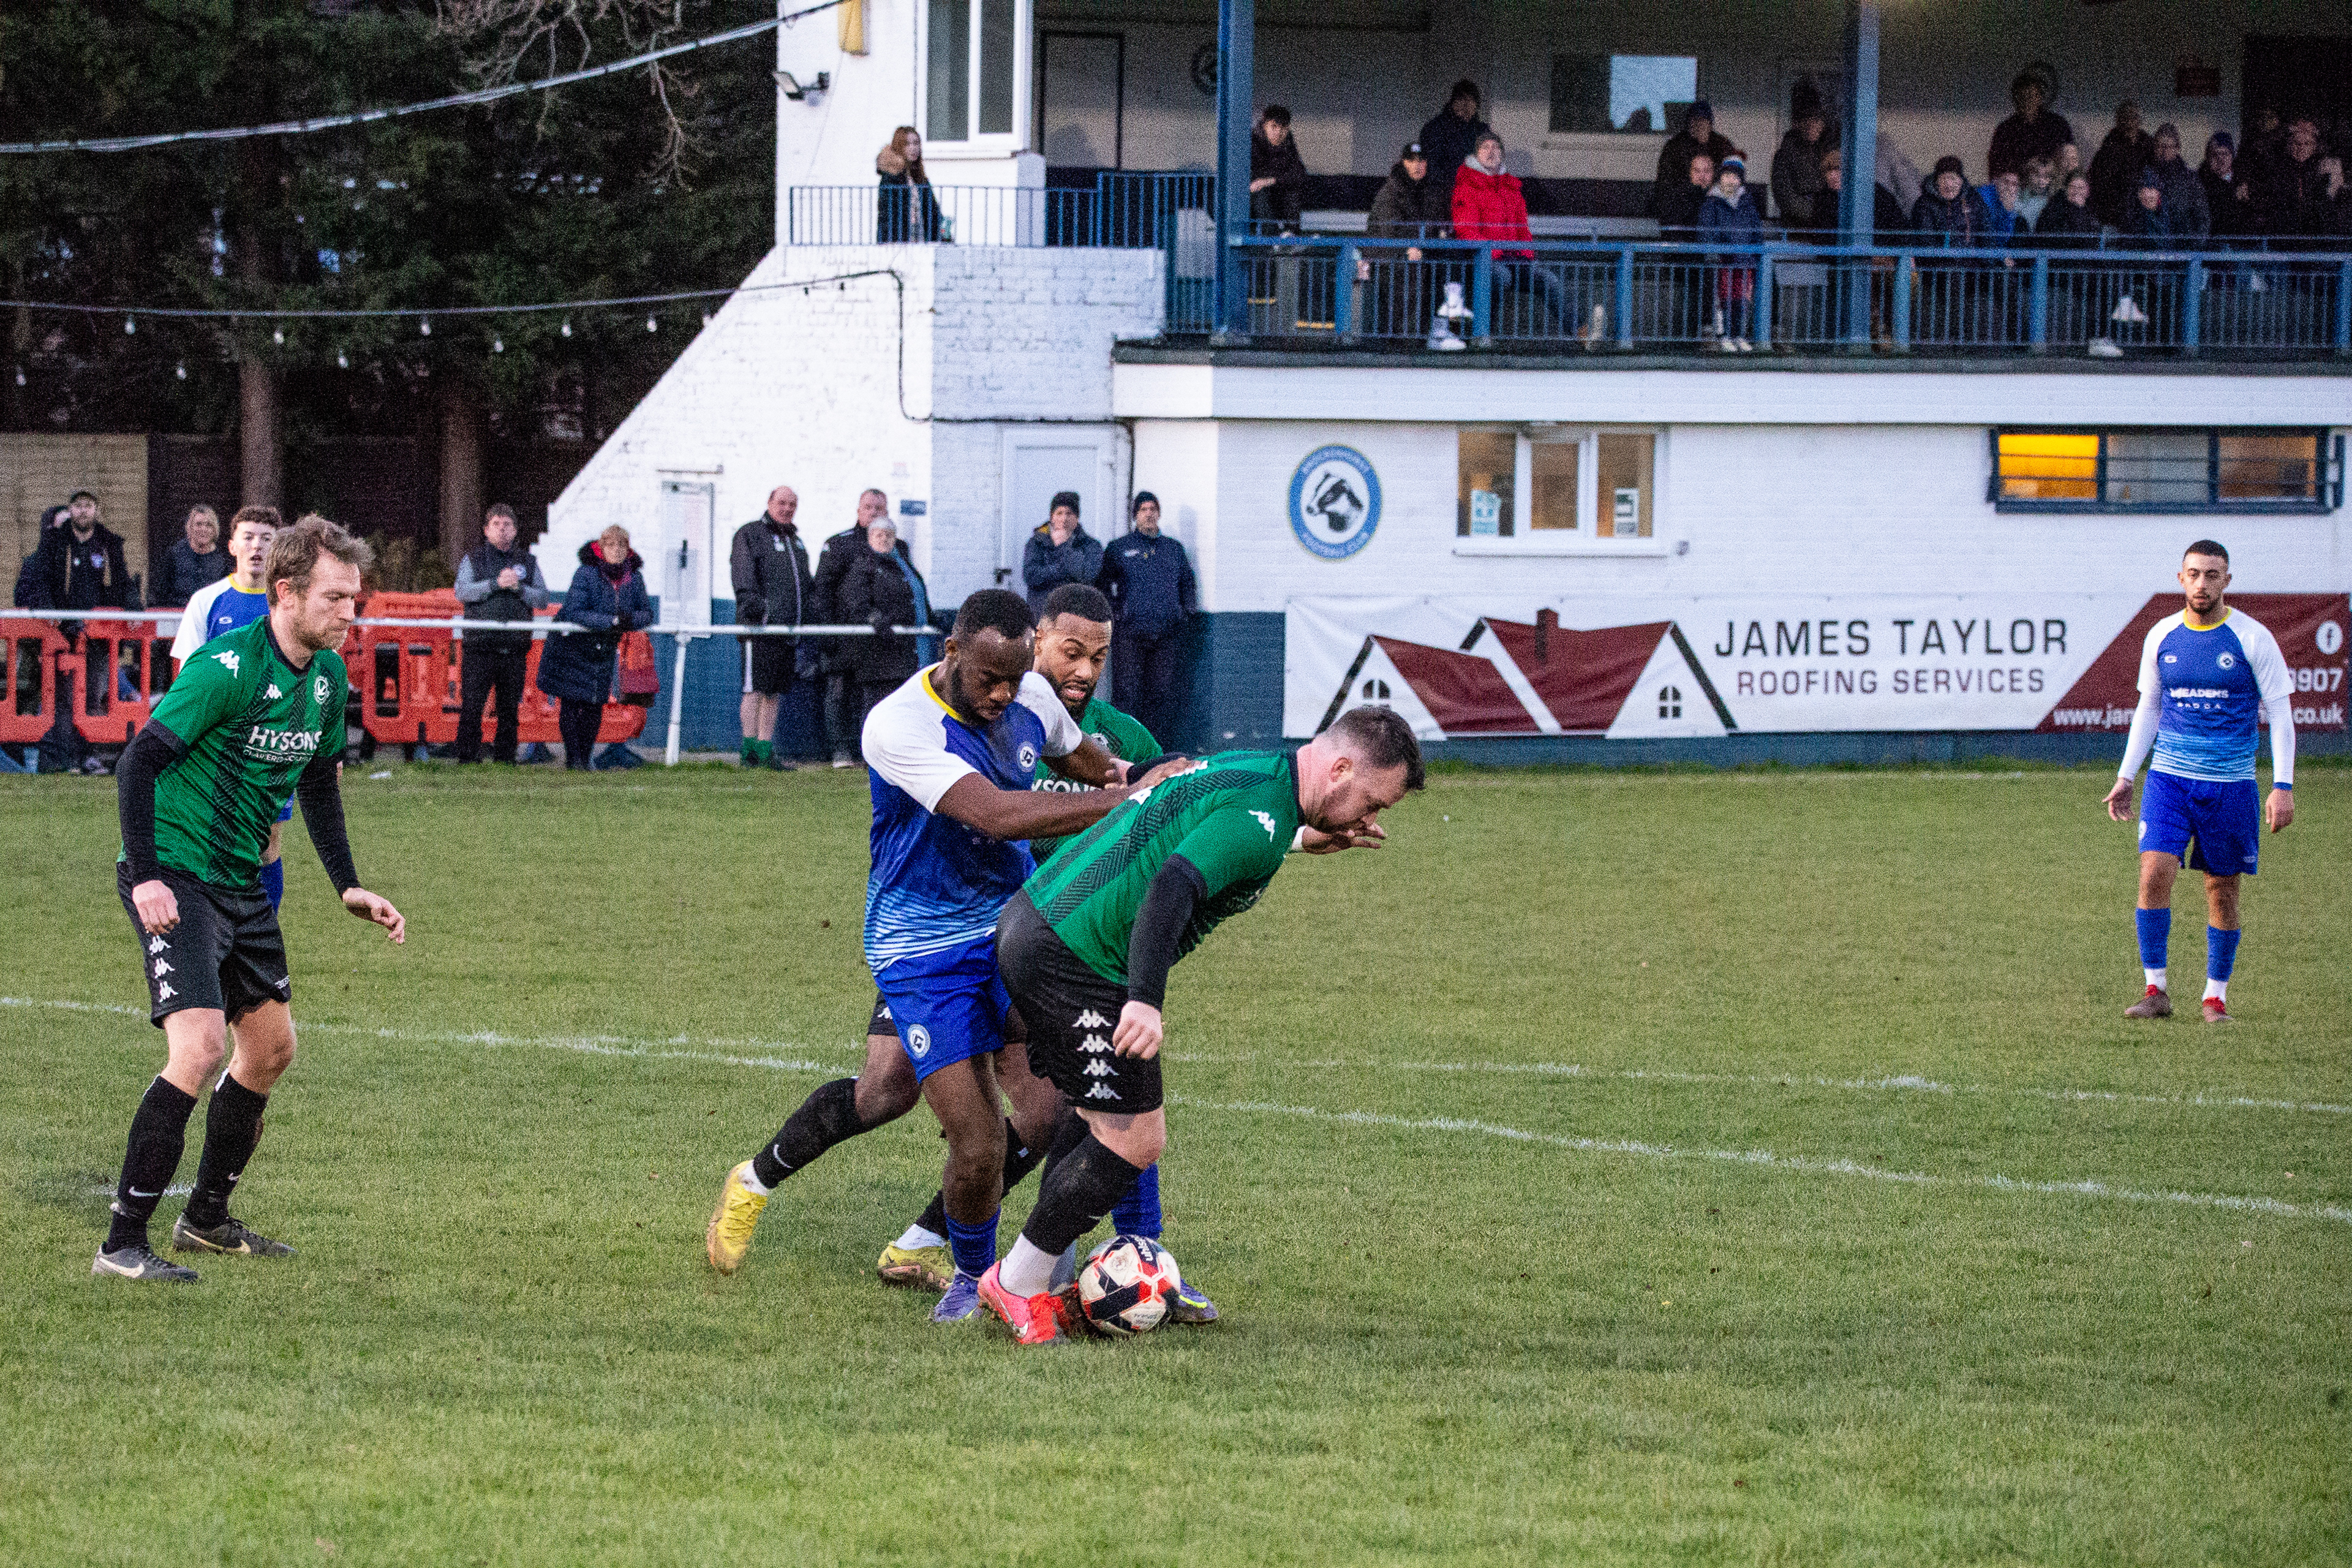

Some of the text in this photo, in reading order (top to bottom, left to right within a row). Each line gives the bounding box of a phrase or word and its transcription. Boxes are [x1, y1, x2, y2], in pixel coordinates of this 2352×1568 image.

[1715, 619, 2067, 657] JAMES TAYLOR
[1738, 668, 2045, 695] ROOFING SERVICES
